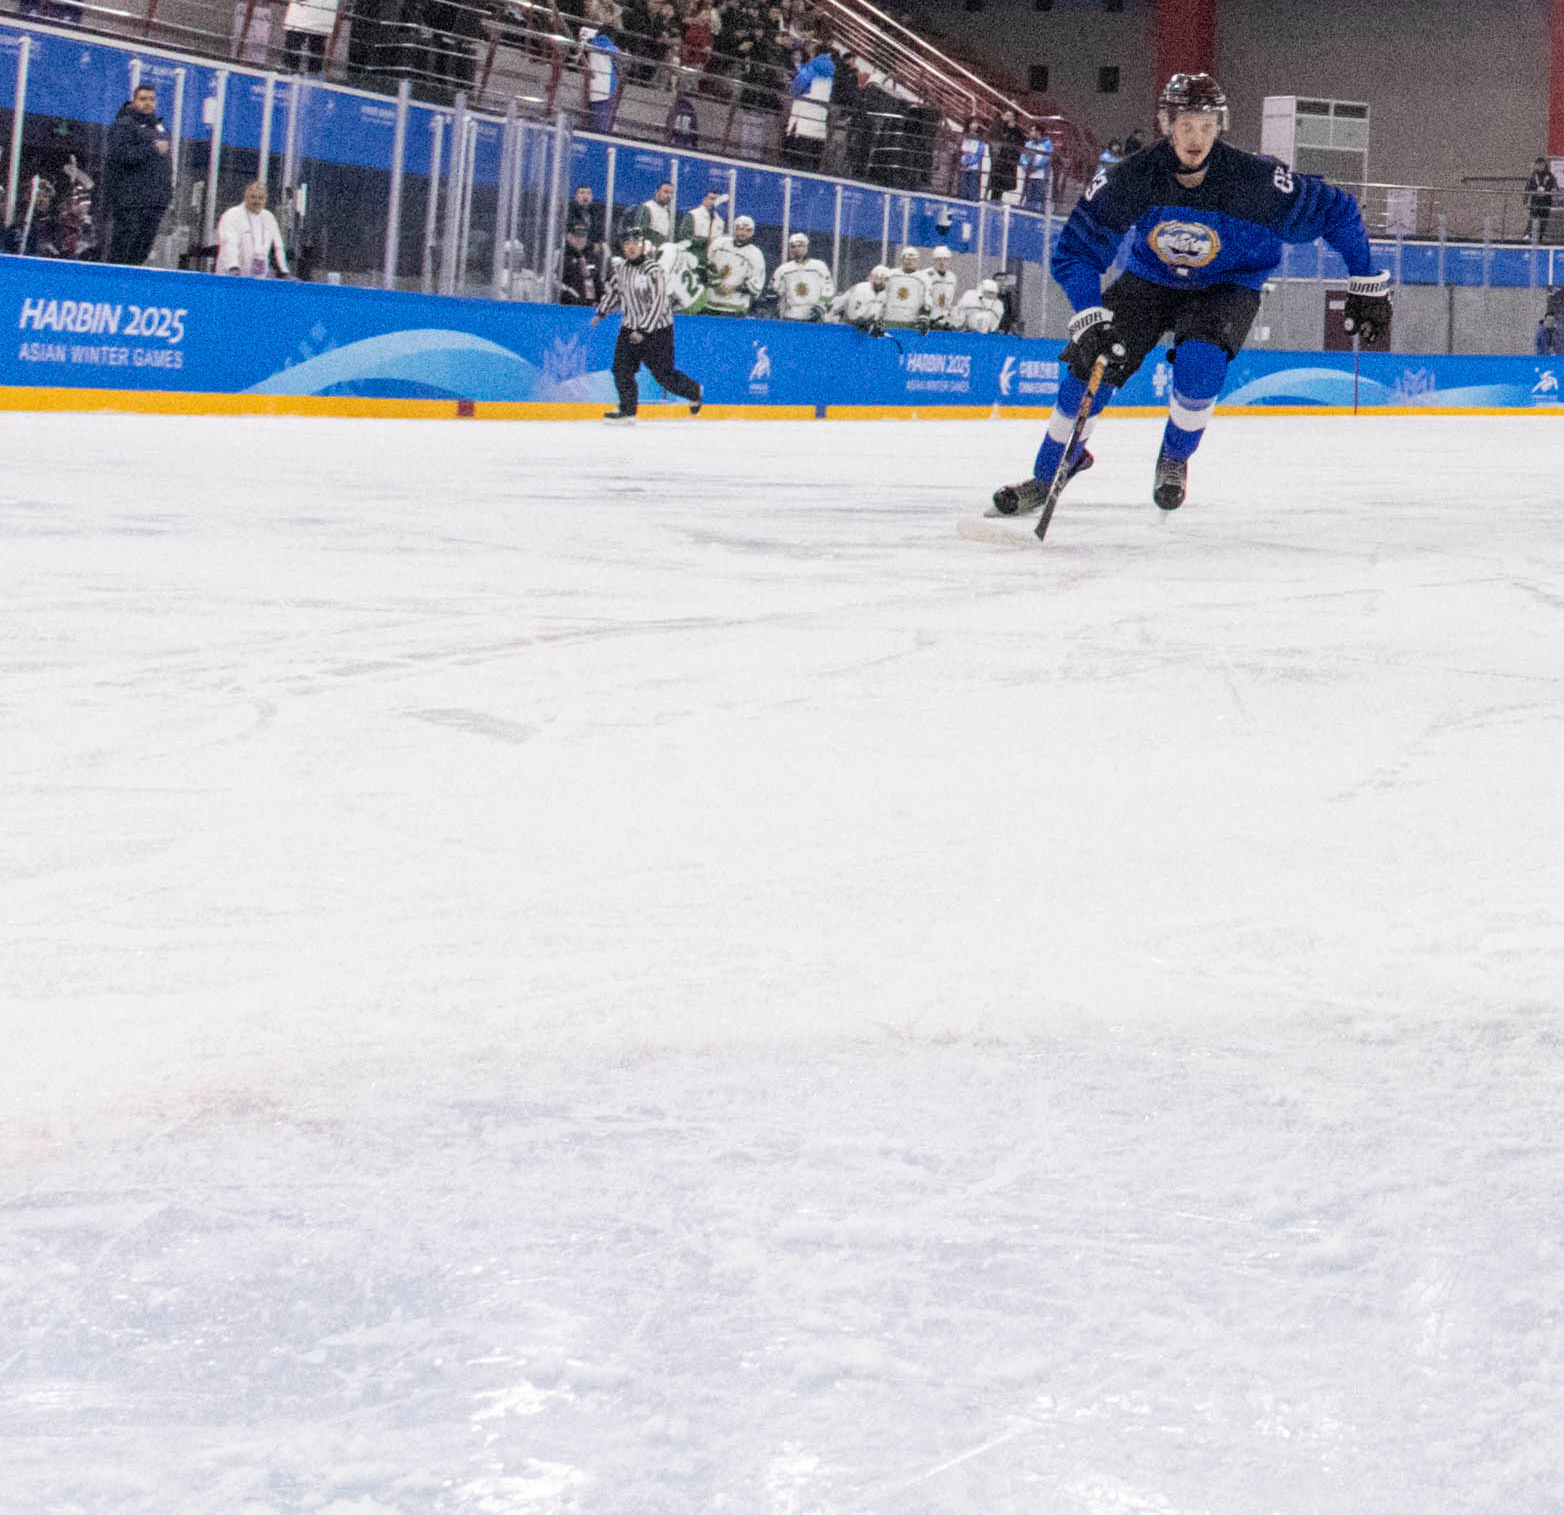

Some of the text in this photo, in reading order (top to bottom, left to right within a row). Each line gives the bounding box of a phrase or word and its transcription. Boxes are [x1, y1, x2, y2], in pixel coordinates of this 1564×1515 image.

[18, 297, 189, 345] HARBIN 2025
[18, 342, 183, 369] ASIAN WINTER GAMES
